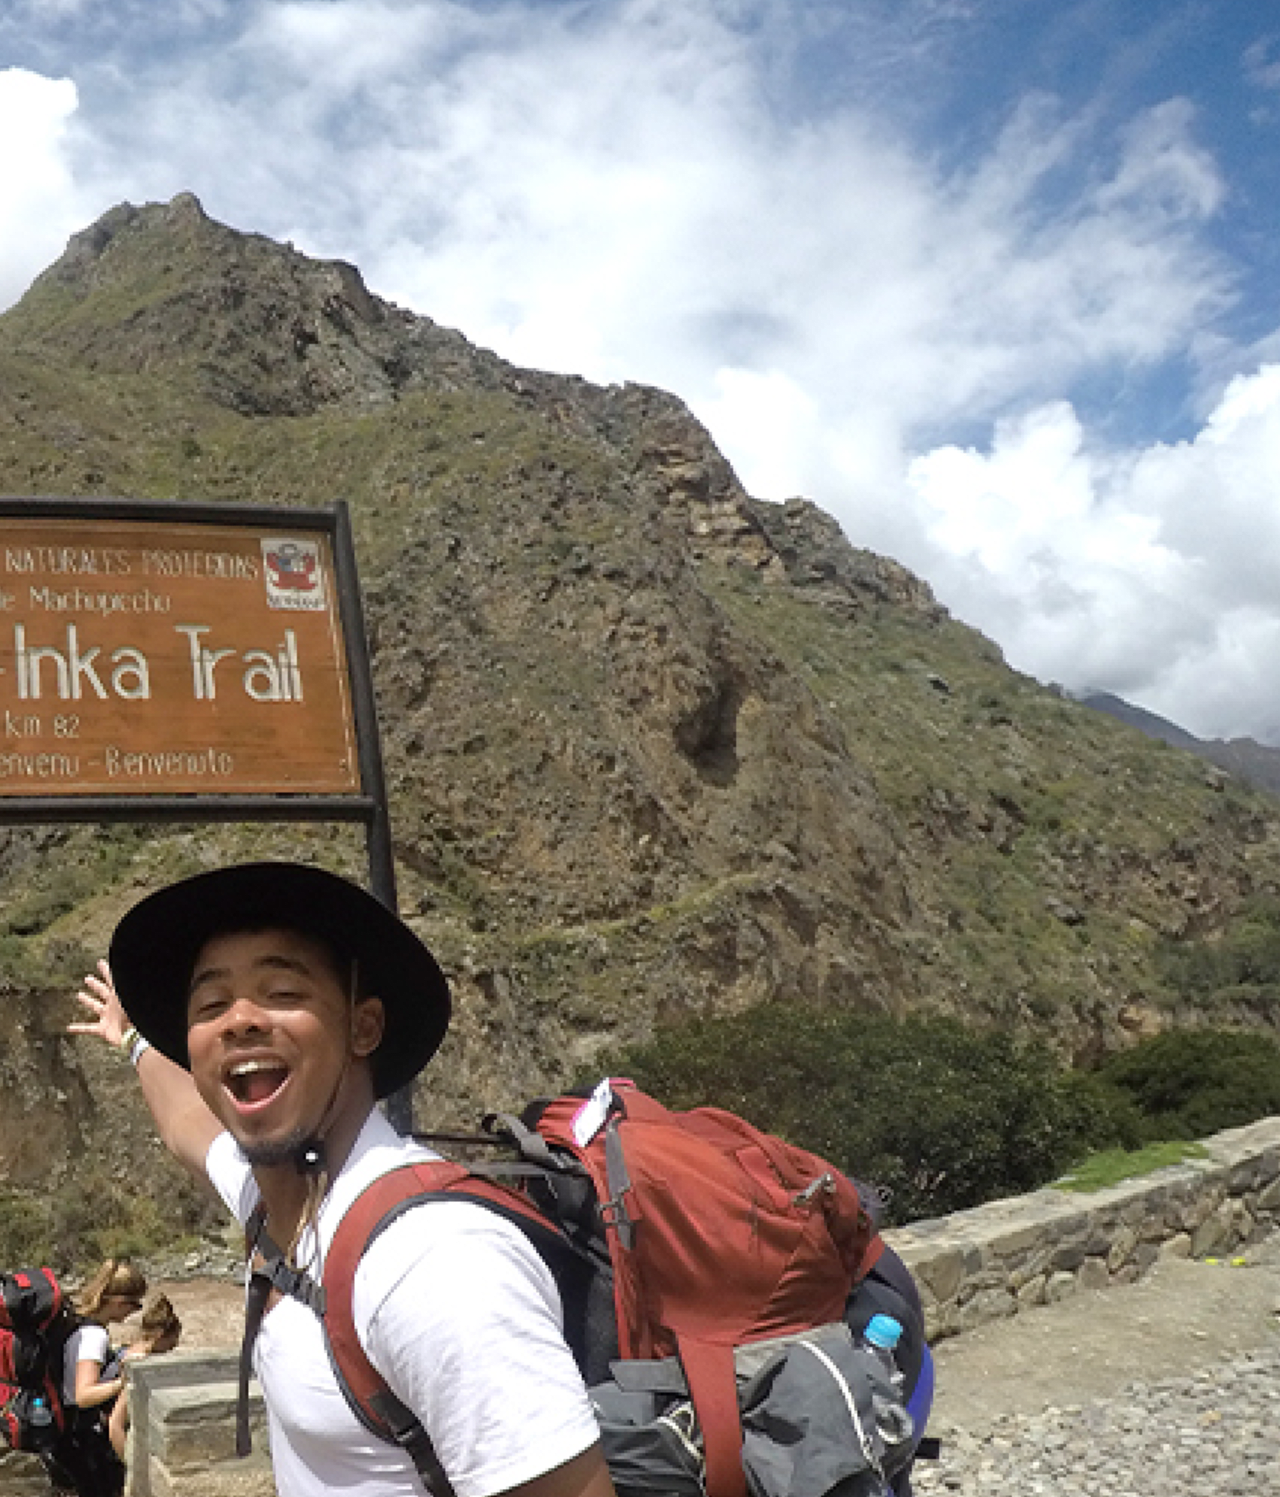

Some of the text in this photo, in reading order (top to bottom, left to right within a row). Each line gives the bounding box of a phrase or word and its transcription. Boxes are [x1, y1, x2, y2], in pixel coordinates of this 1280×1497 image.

[5, 546, 131, 575] NATURALES
[14, 622, 150, 700] Inka
[173, 622, 304, 702] Trail
[53, 713, 81, 739] 82
